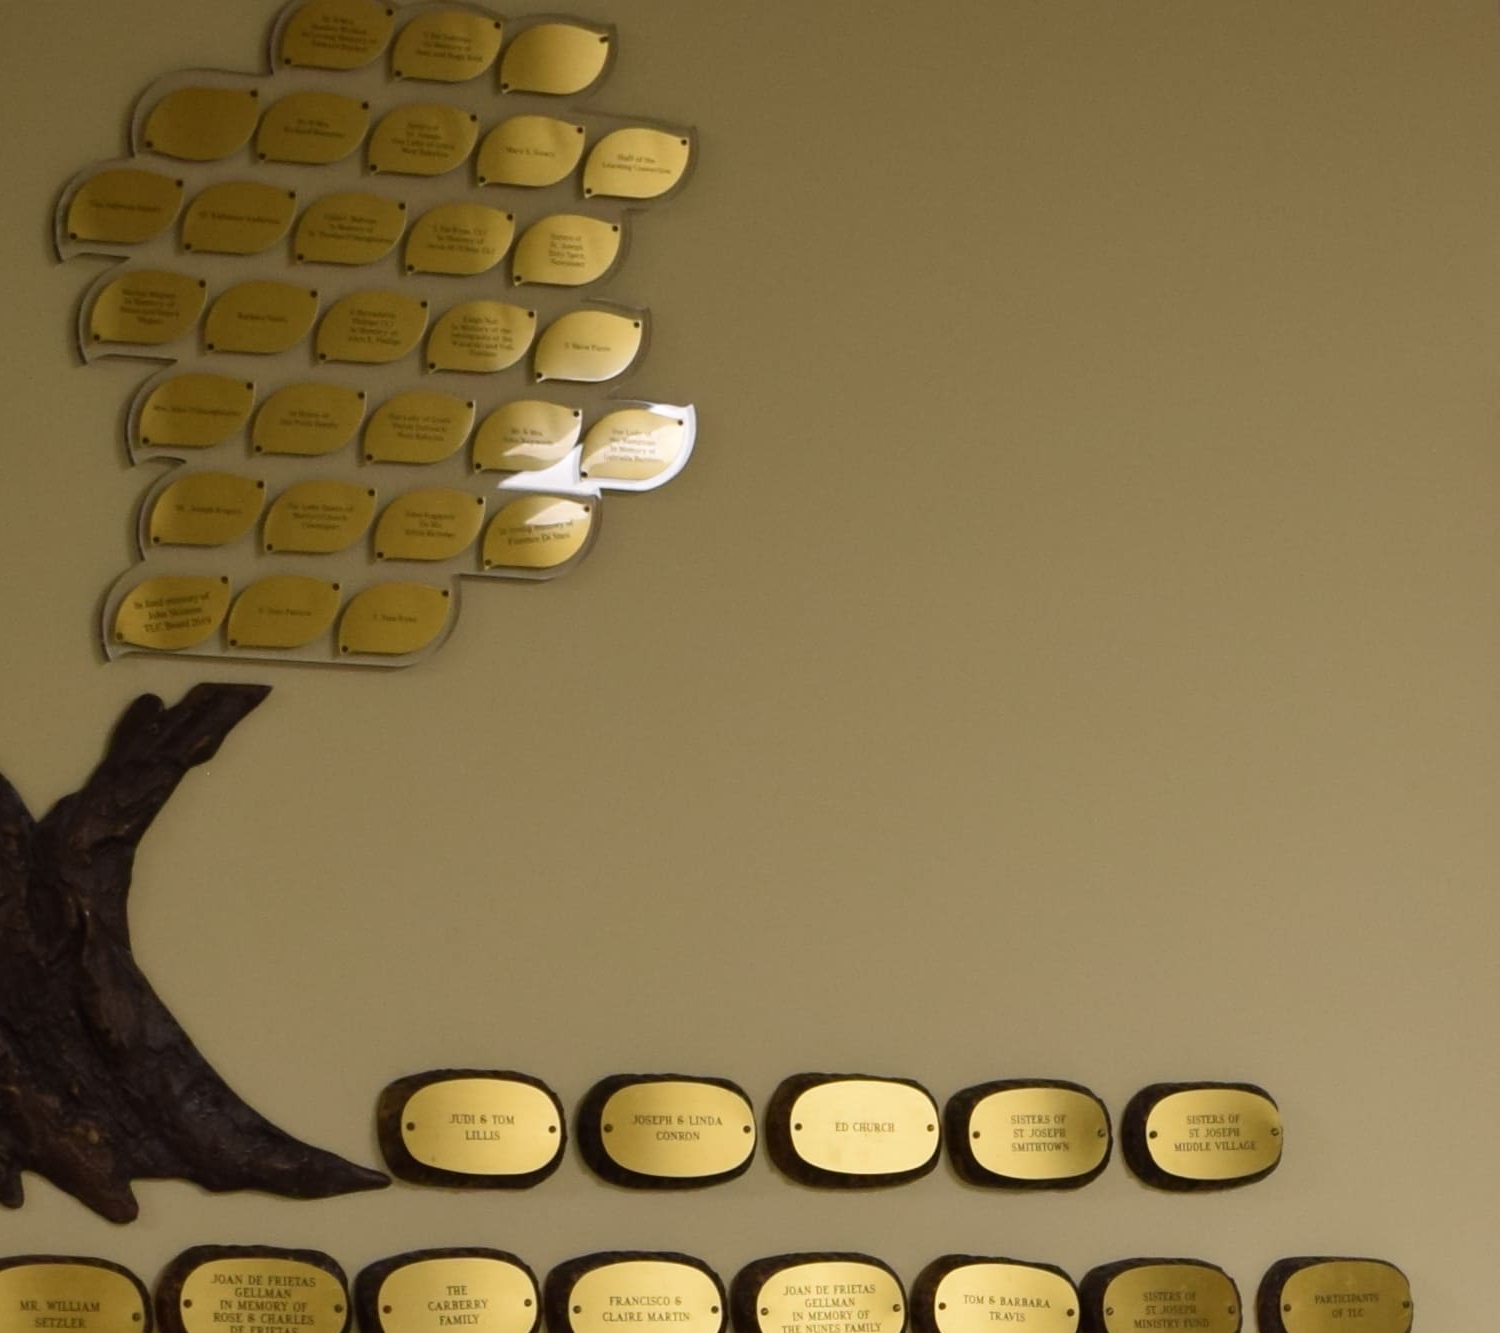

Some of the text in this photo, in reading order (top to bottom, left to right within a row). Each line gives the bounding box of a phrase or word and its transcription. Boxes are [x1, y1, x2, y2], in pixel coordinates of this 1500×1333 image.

[449, 1114, 514, 1125] JUDI & TOM
[632, 1114, 723, 1126] JOSEPH & LINDA
[1011, 1114, 1067, 1125] SISTERS OF
[1187, 1114, 1240, 1125] SISTERS OF
[835, 1122, 894, 1132] ED CHURCH
[1189, 1127, 1240, 1138] ST JOSEPH
[465, 1130, 500, 1140] LILLIS
[656, 1131, 700, 1141] CONRON
[1013, 1128, 1066, 1138] ST JOSEPH
[1012, 1141, 1069, 1152] SMITHTOWN
[1174, 1140, 1256, 1152] MIDDLE VILLAGE
[211, 1274, 243, 1285] JOAN
[248, 1275, 263, 1286] DE
[234, 1287, 292, 1299] GELLMAN
[446, 1285, 468, 1296] THE
[783, 1286, 811, 1296] JOAN
[816, 1285, 829, 1295] DE
[609, 1296, 670, 1306] FRANCISCO
[964, 1295, 1050, 1309] TOM & BARBARA
[1143, 1292, 1196, 1302] SISTERS OF
[1315, 1293, 1379, 1304] PARTICIPANTS
[46, 1300, 100, 1313] WILLIAM
[220, 1299, 307, 1312] IN MEMORY OF
[428, 1299, 488, 1311] CARBERRY
[805, 1298, 855, 1308] GELLMAN
[1160, 1304, 1197, 1315] JOSEPH
[1332, 1307, 1364, 1318] OF TLC
[213, 1312, 242, 1323] ROSE
[260, 1313, 315, 1326] CHARLES
[439, 1314, 479, 1326] FAMILY
[602, 1312, 690, 1322] CLAIRE MARTIN
[793, 1310, 870, 1321] IN MEMORY OF
[989, 1311, 1025, 1322] TRAVIS
[34, 1317, 87, 1329] SETZLER
[806, 1324, 841, 1333] NUNES
[845, 1322, 881, 1333] FAMILY
[1134, 1317, 1209, 1329] MINISTRY FUND
